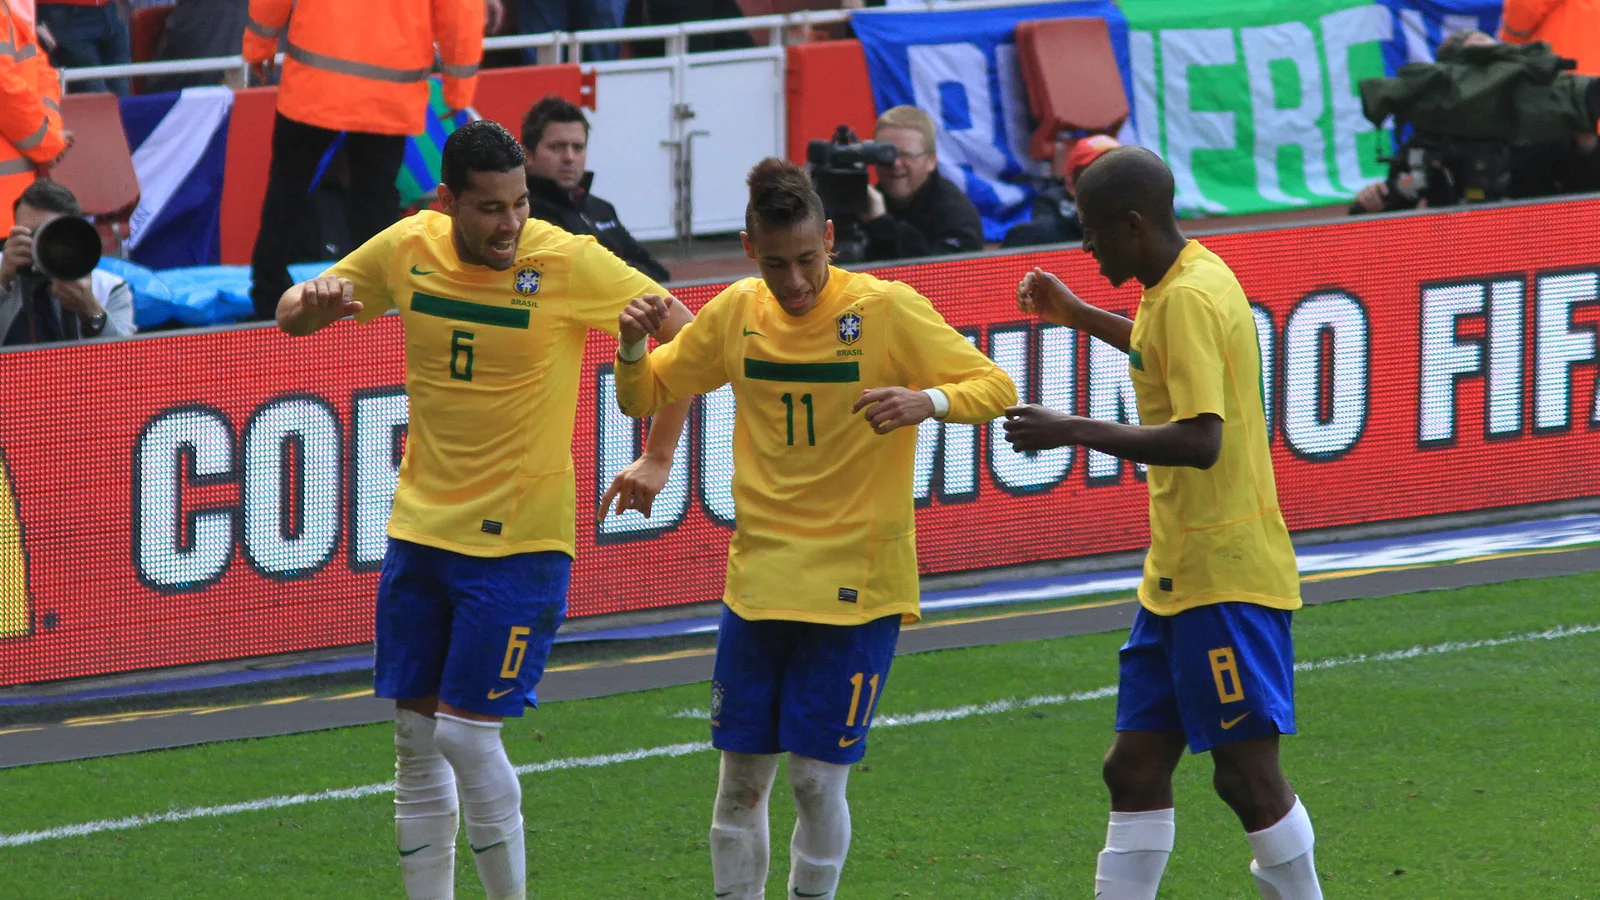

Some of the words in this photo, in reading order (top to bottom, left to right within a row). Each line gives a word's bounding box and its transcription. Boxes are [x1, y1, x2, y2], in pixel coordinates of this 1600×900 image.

[511, 298, 539, 308] BRASIL
[450, 329, 475, 382] 6
[836, 349, 864, 357] BRASIL
[136, 389, 409, 588] COP
[1419, 270, 1600, 445] FIF
[780, 392, 816, 447] 11
[500, 626, 531, 678] 6
[1207, 646, 1245, 704] 8
[845, 672, 880, 727] 11
